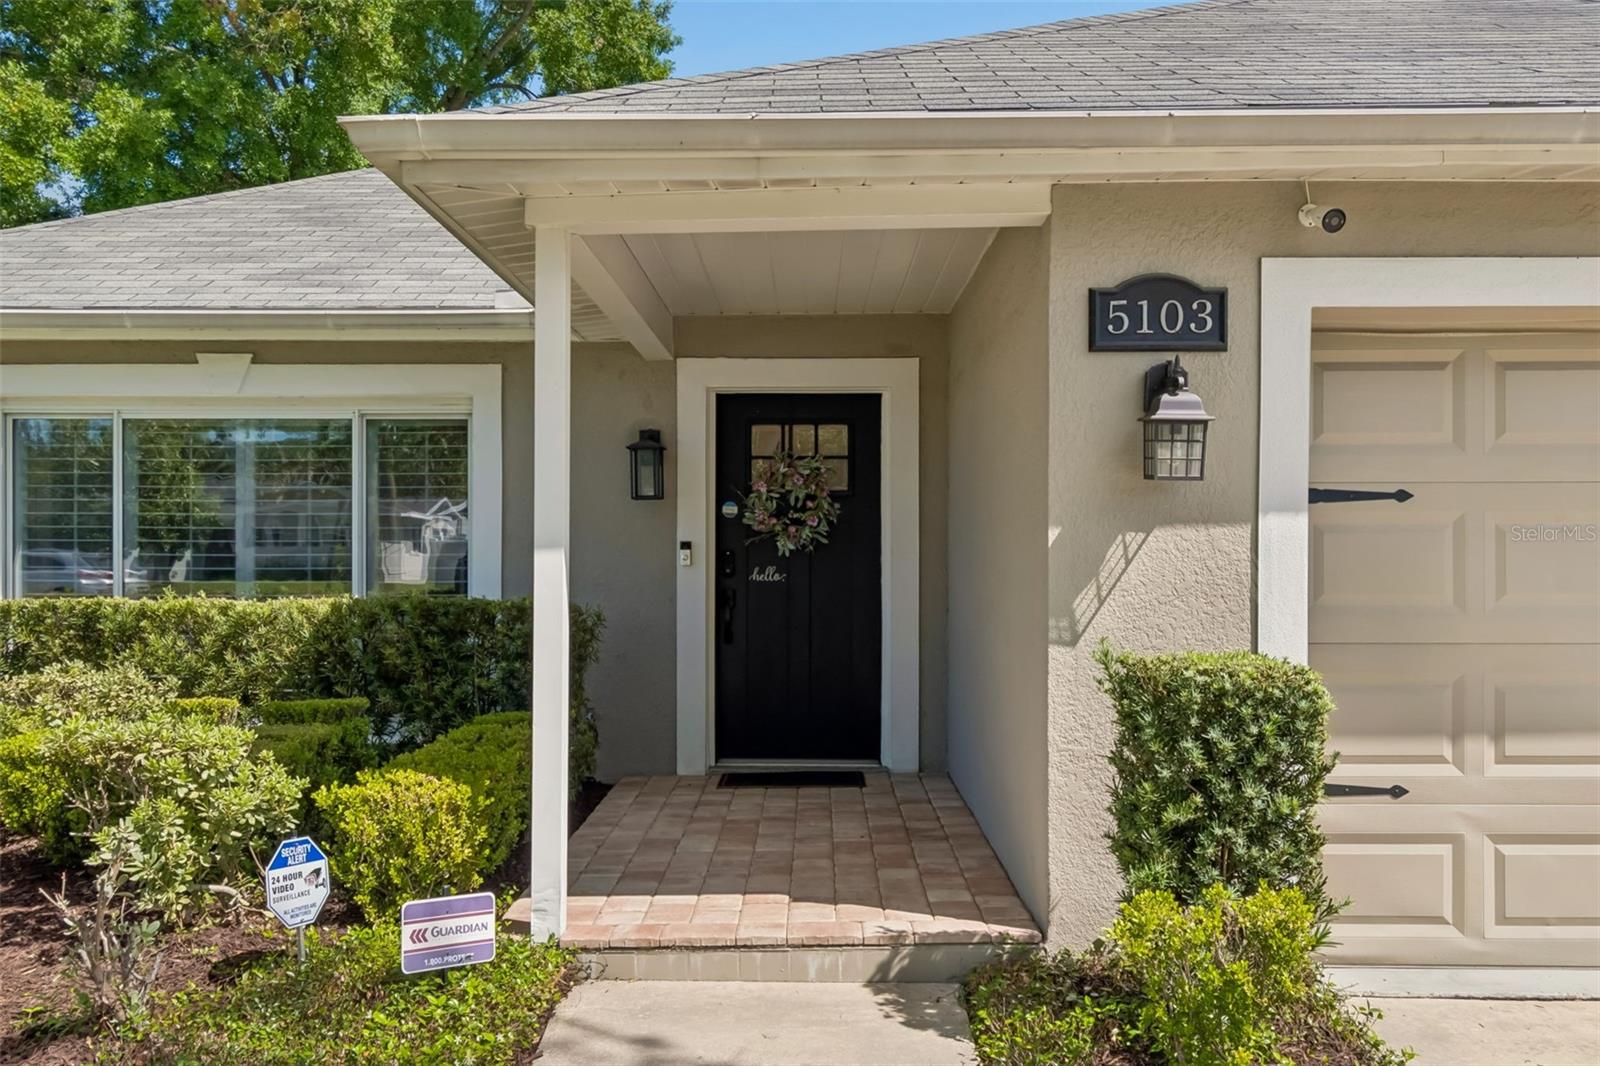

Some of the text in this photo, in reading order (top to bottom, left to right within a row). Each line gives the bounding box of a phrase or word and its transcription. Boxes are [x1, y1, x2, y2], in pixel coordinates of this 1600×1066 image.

[1107, 299, 1213, 334] 5103
[281, 843, 312, 858] SECURITY
[287, 853, 307, 867] ALERT
[271, 871, 304, 885] 24 HOUR
[272, 882, 295, 895] VIDEO
[272, 889, 311, 904] SURVEILLANCE
[430, 921, 489, 938] GUARDIAN
